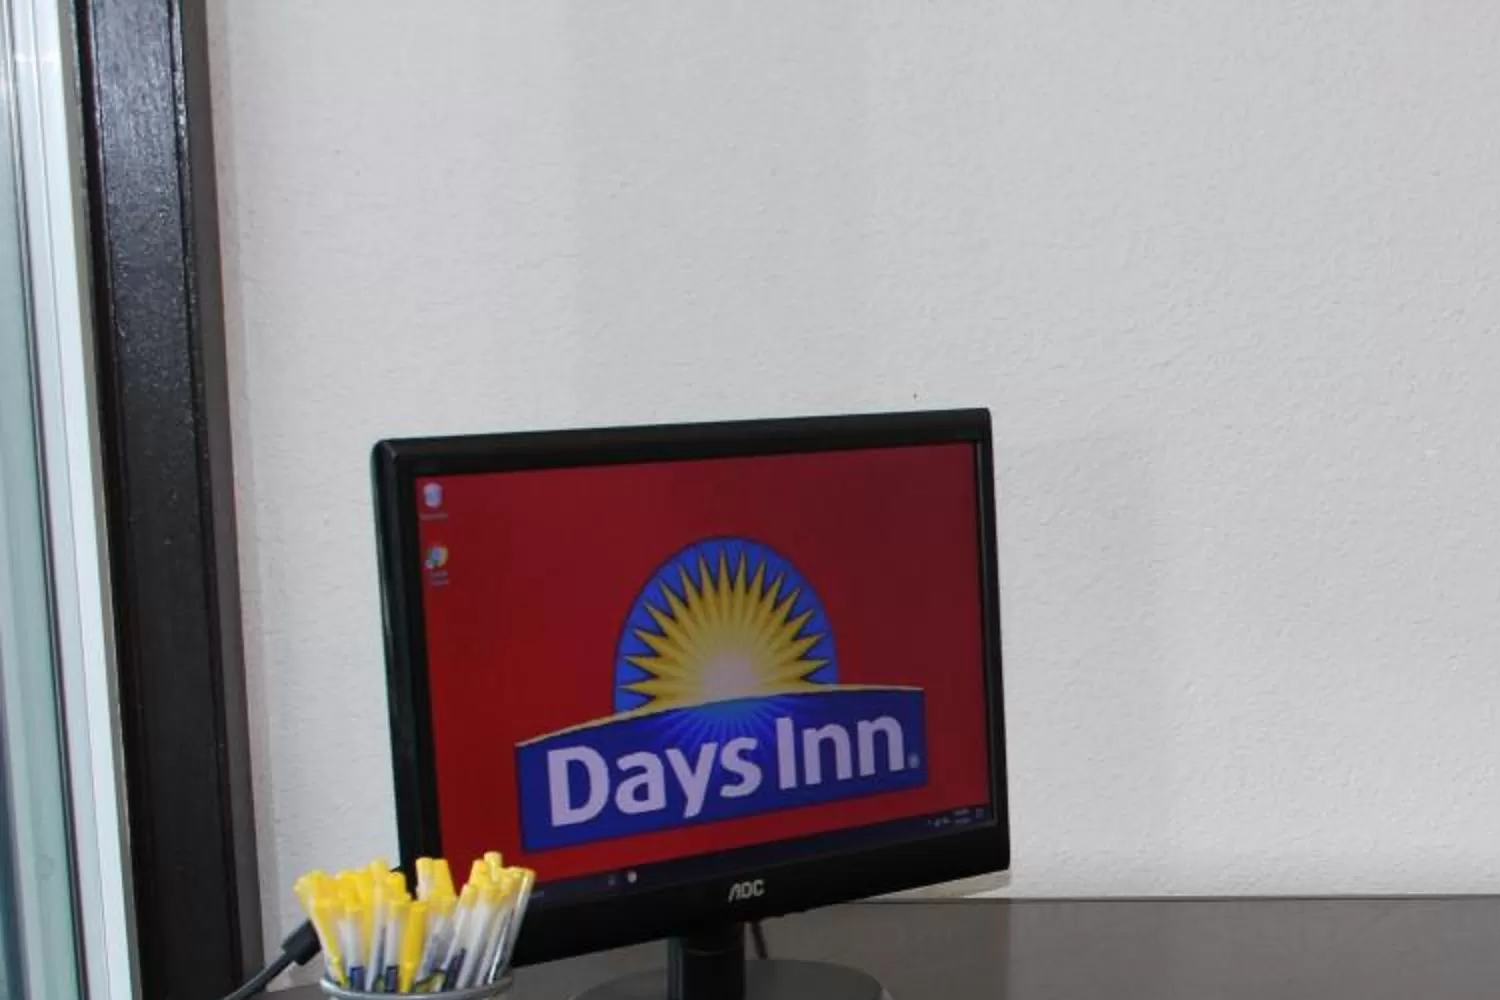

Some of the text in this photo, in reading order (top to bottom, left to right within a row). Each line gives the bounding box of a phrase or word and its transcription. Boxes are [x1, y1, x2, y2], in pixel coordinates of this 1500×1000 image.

[547, 715, 905, 827] Days Inn
[728, 879, 765, 903] AOC
